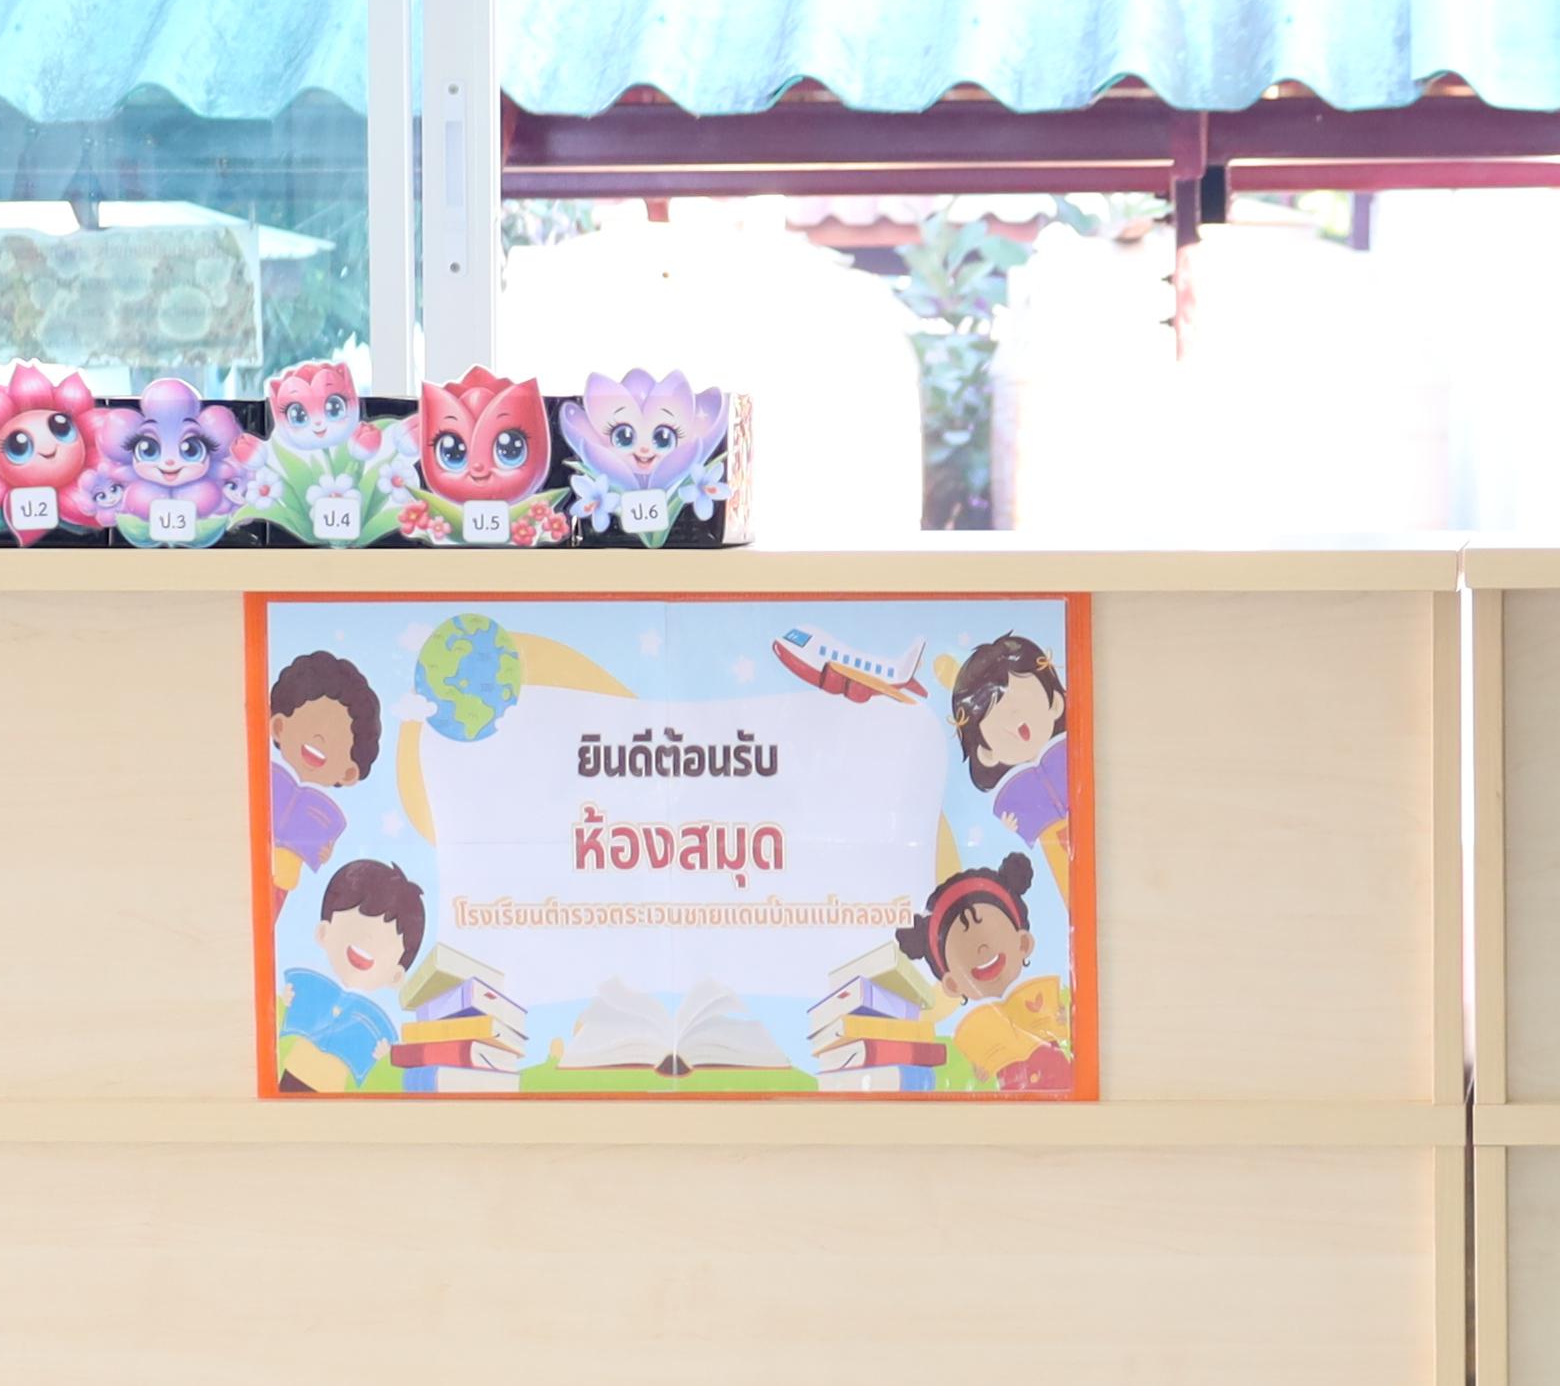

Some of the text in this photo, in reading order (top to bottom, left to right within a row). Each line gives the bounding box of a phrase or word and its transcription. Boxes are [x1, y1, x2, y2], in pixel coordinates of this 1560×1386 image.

[20, 501, 48, 517] ป.2
[631, 503, 659, 521] ป.6
[159, 514, 187, 530] ป.3
[323, 513, 350, 527] ป.4
[472, 515, 500, 531] ป.5
[577, 728, 778, 777] ยินดีต้อนรับ
[575, 806, 784, 887] ห้องสมุด
